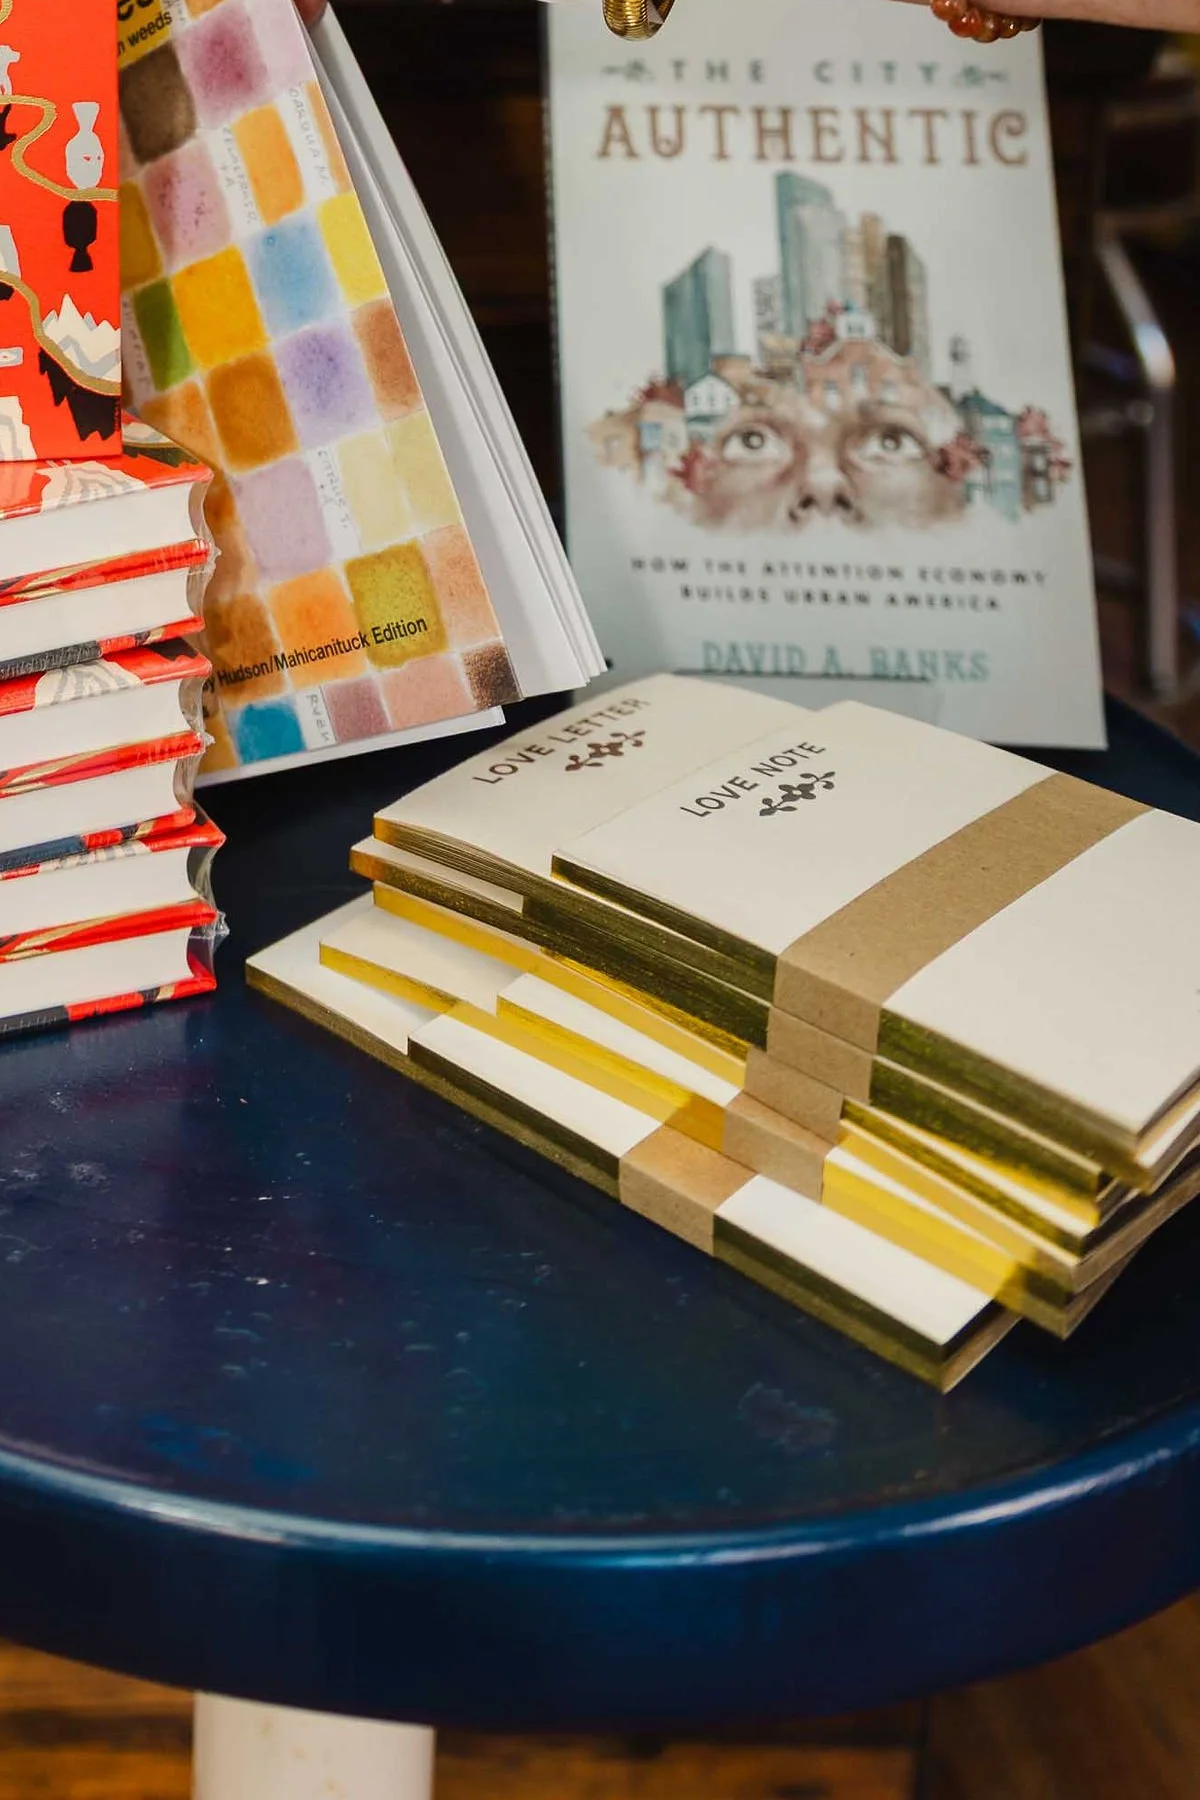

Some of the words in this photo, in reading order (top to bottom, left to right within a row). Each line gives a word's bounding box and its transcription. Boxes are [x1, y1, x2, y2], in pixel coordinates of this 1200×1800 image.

[127, 11, 173, 48] weeds
[669, 58, 766, 83] THE
[812, 60, 939, 85] CITY
[596, 103, 1030, 167] AUTHENTIC
[631, 556, 690, 574] HOW
[704, 559, 748, 576] THE
[761, 561, 905, 582] ATTENTION
[918, 565, 1048, 588] ECONOMY
[680, 583, 770, 602] BUILDS
[783, 588, 871, 608] URBAN
[885, 591, 1003, 613] AMERICA
[217, 631, 370, 686] Hudson/Mahicanituck
[371, 616, 429, 646] Edition
[701, 641, 806, 676] DAVID
[820, 645, 857, 680] A.
[869, 646, 991, 684] BANKS
[472, 744, 556, 785] LOVE
[547, 697, 652, 745] LETTER
[679, 775, 760, 818] LOVE
[750, 741, 828, 778] NOTE
